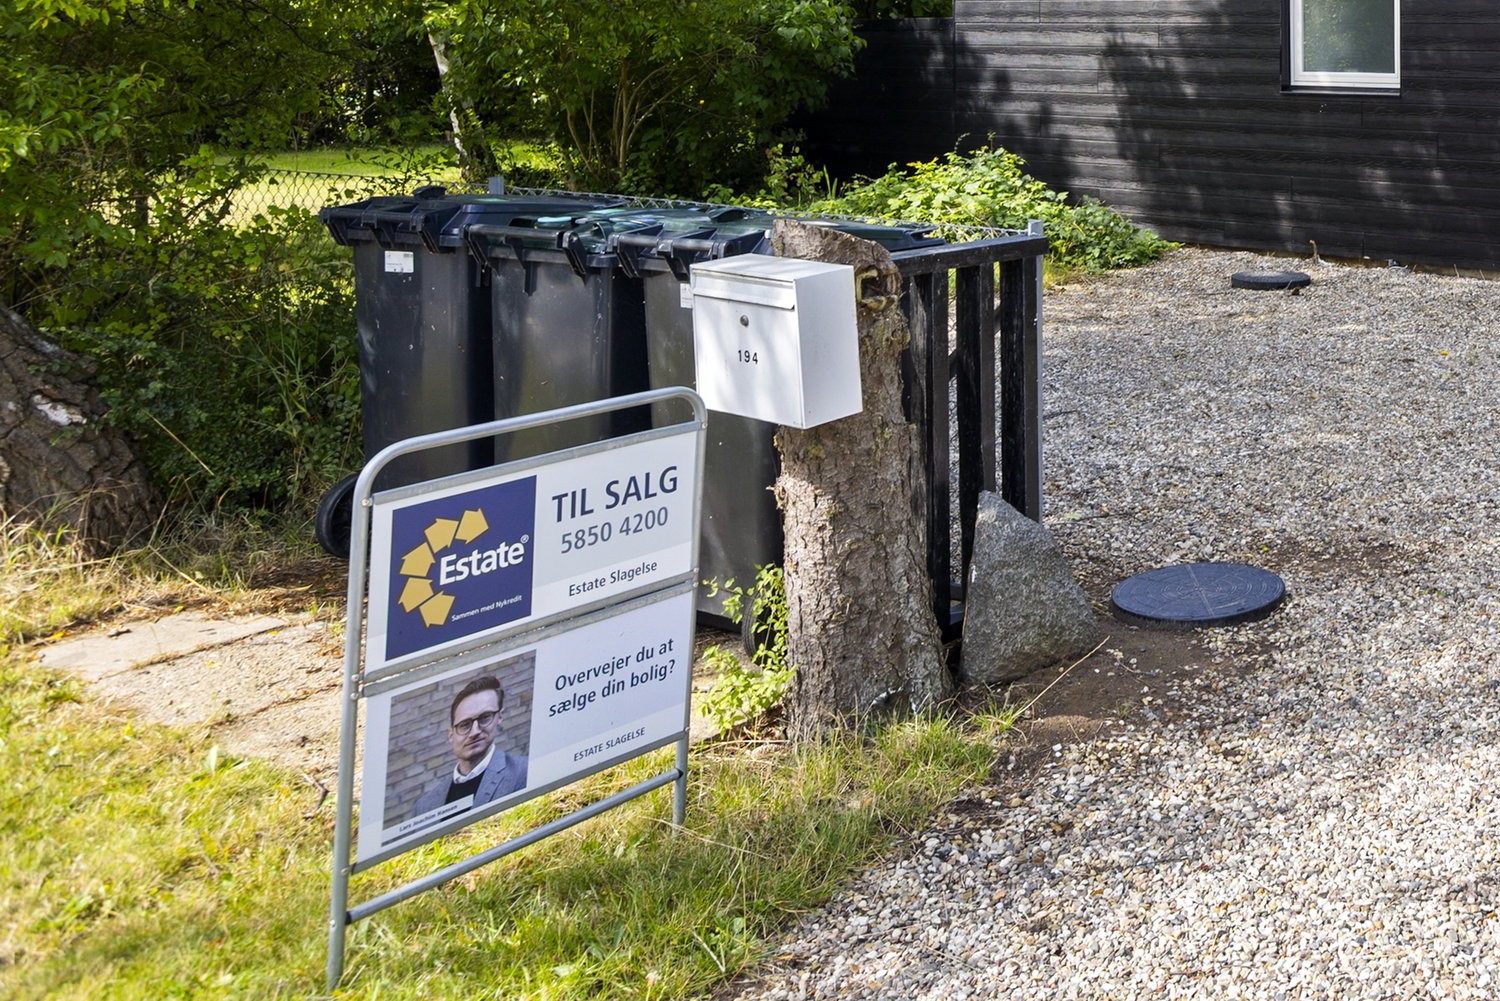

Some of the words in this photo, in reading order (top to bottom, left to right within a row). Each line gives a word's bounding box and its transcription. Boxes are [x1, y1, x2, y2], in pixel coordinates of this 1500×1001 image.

[738, 349, 758, 364] 194
[551, 488, 594, 522] TIL
[605, 466, 677, 509] SALG
[561, 522, 612, 554] 5850
[619, 507, 668, 536] 4200
[569, 577, 606, 596] Estate
[610, 561, 657, 584] Slagelse
[452, 609, 479, 622] Sammen
[480, 602, 495, 613] med
[495, 595, 523, 610] Nykredit
[555, 656, 631, 691] Overvejer
[636, 646, 654, 663] du
[659, 638, 673, 655] at
[549, 692, 596, 718] sælge
[601, 679, 625, 698] din
[630, 659, 676, 688] bolig?
[574, 743, 603, 762] ESTATE
[606, 727, 645, 750] SLAGELSE
